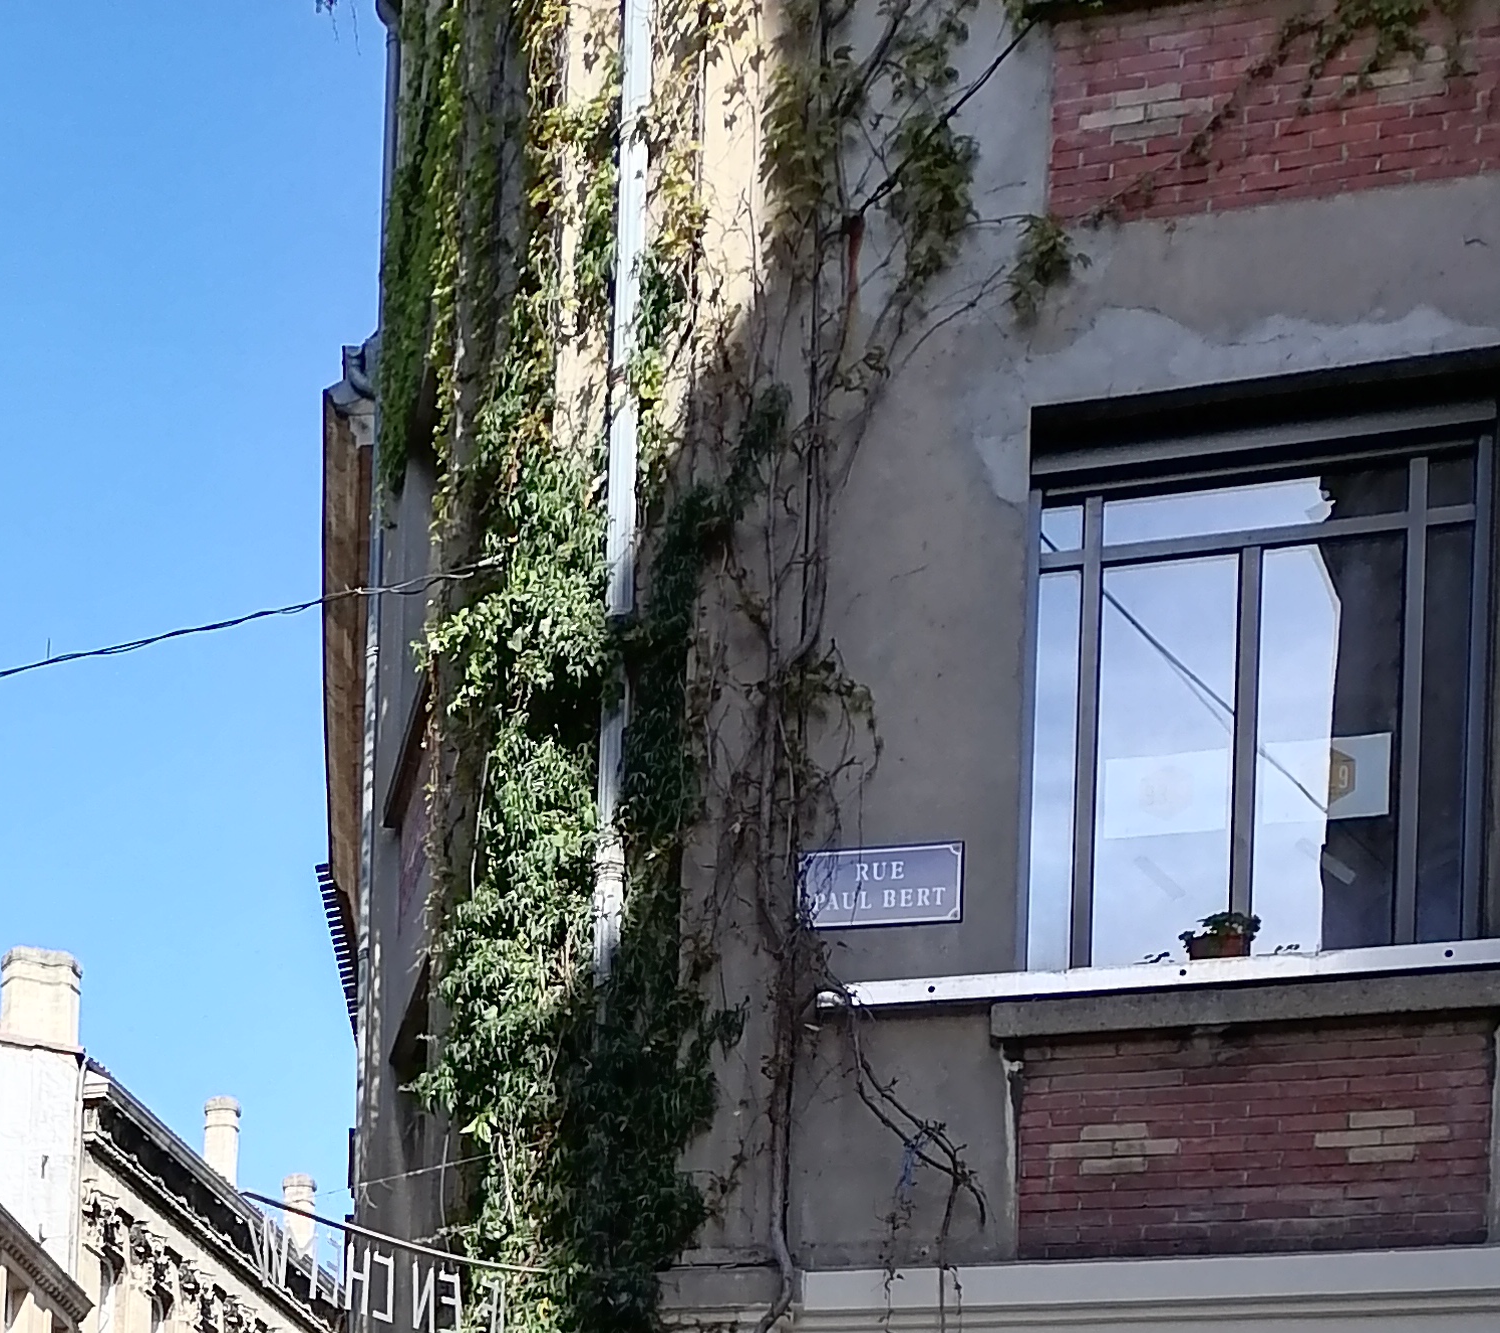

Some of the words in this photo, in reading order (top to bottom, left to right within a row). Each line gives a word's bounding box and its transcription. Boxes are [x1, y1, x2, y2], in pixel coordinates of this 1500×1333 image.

[855, 861, 905, 881] RUE
[813, 889, 872, 911] PAUL
[883, 886, 946, 908] BERT
